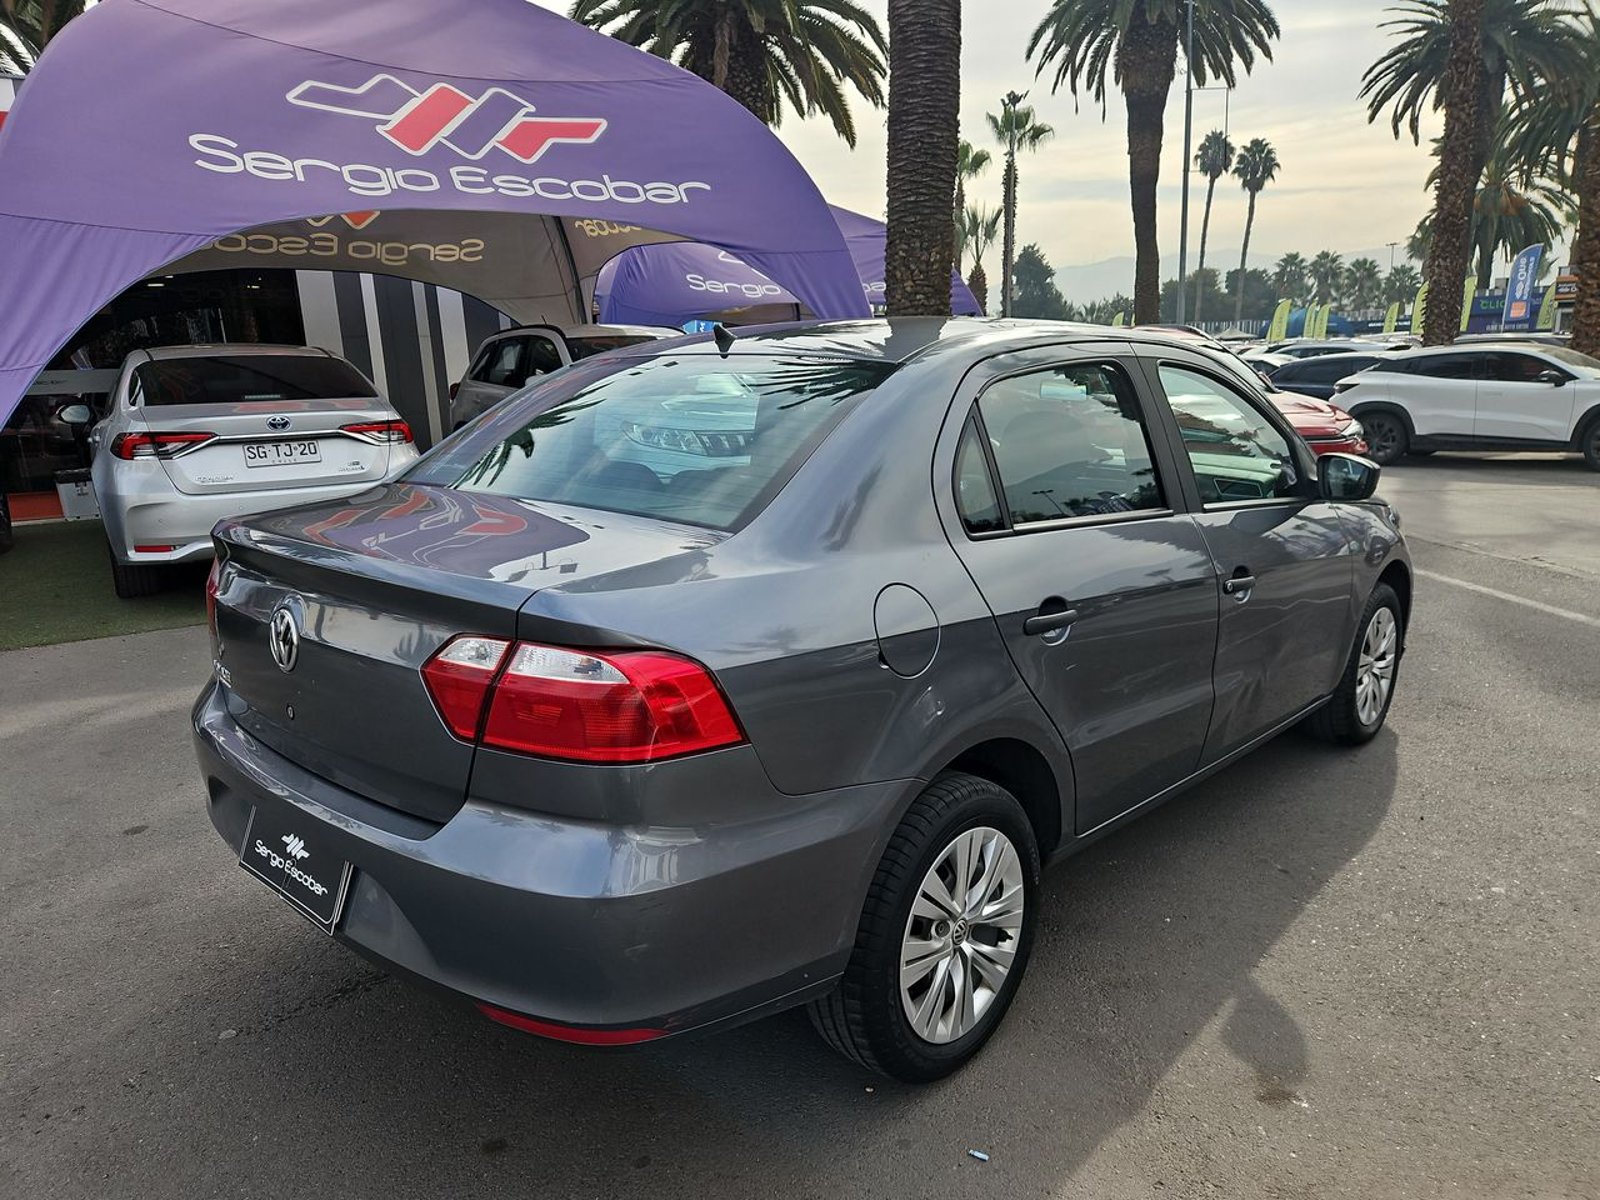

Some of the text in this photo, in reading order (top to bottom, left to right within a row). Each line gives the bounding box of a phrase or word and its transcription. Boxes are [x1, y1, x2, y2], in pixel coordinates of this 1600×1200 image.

[188, 133, 711, 204] Sergio Escobar
[686, 274, 782, 297] Sergio
[284, 859, 329, 896] Escobar
